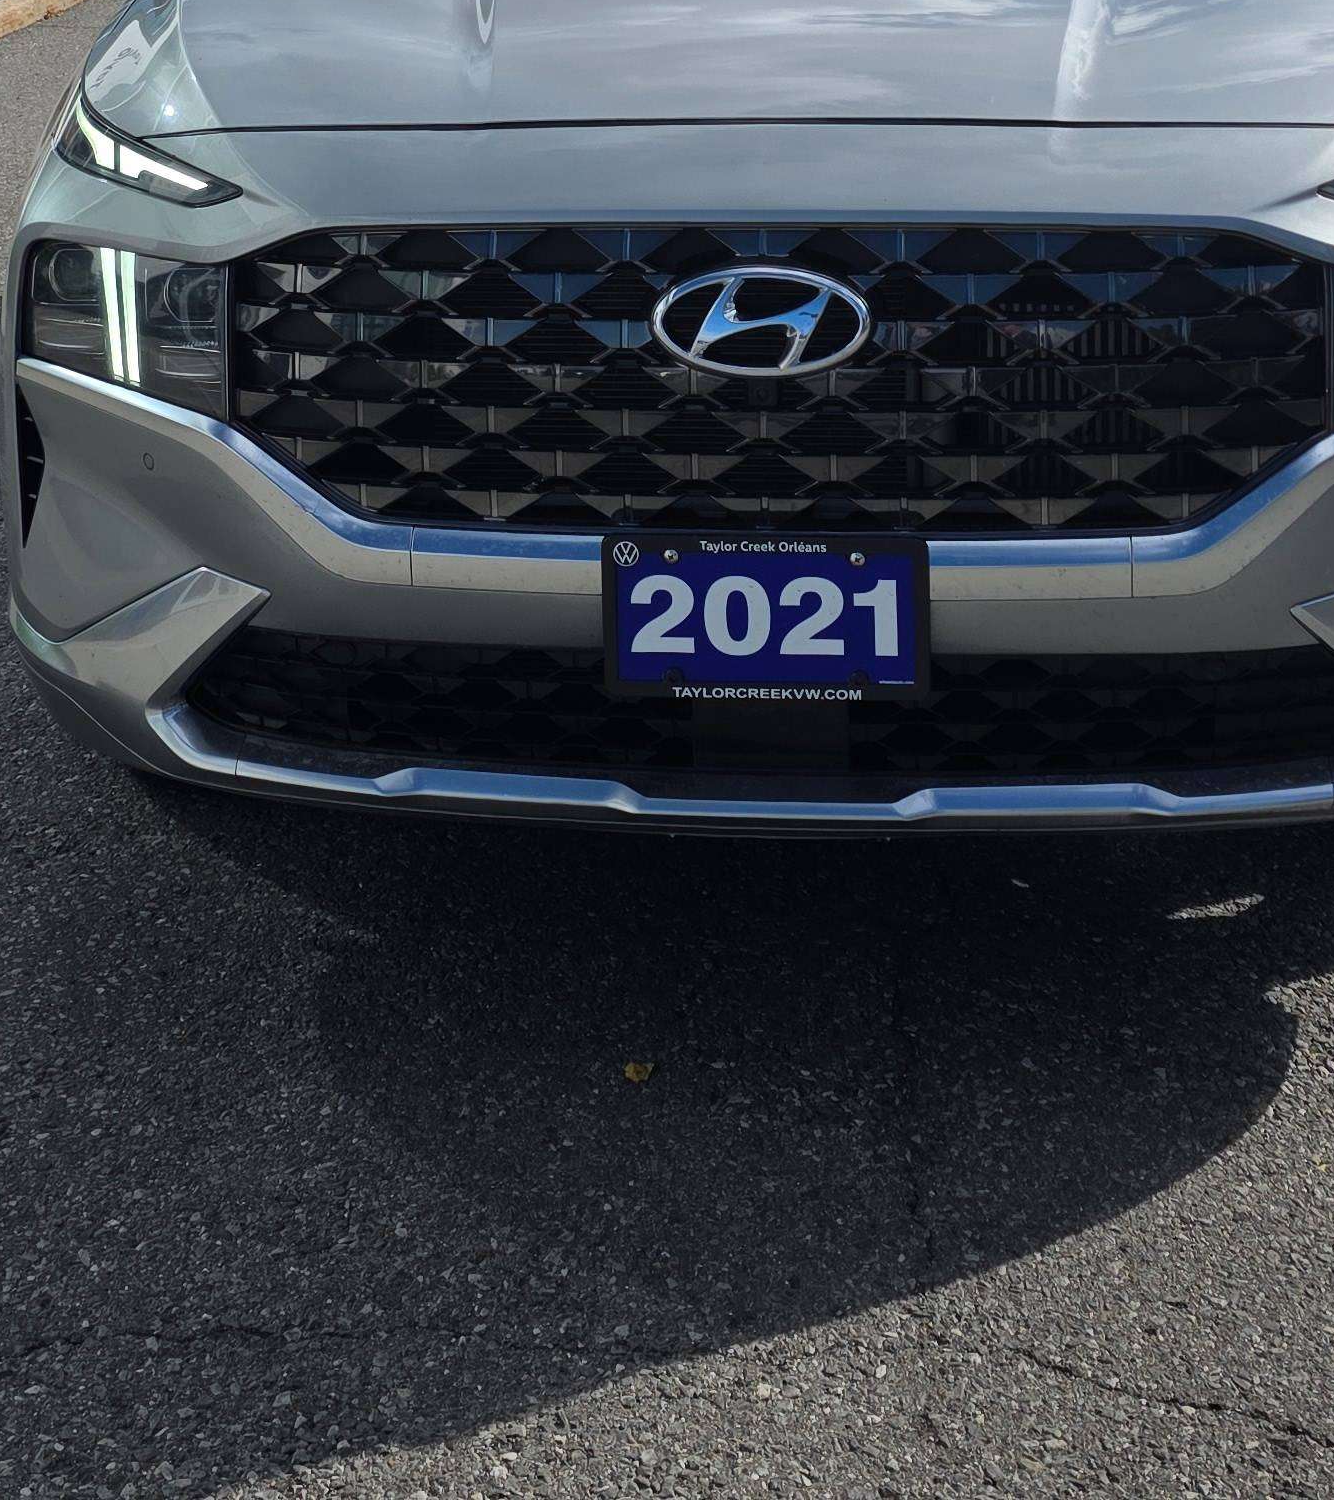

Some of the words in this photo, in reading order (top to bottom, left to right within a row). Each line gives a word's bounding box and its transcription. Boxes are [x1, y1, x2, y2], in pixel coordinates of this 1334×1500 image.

[699, 540, 738, 553] Taylor
[740, 541, 775, 553] Creek
[778, 541, 827, 553] Orléans
[630, 574, 899, 657] 2021
[672, 686, 862, 701] TAYLORCREEKVW.COM
